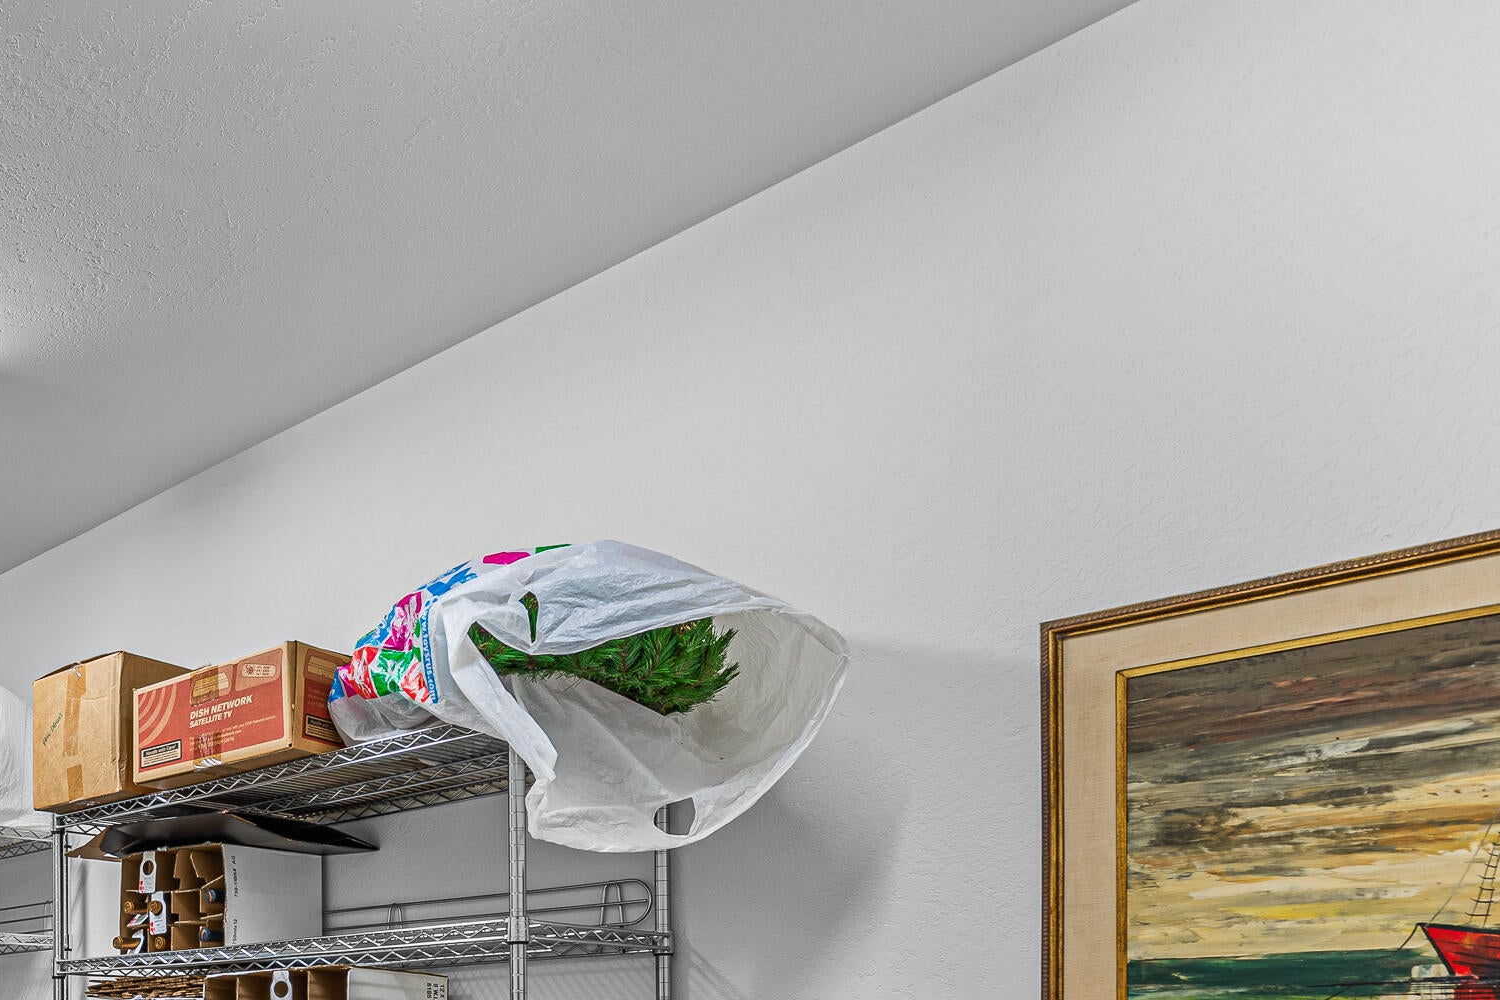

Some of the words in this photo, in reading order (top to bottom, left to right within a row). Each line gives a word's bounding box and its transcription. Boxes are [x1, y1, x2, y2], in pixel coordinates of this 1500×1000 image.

[190, 706, 210, 720] DISH
[210, 695, 253, 715] NETWORK
[189, 712, 223, 728] SATELLITE
[223, 710, 233, 719] TV
